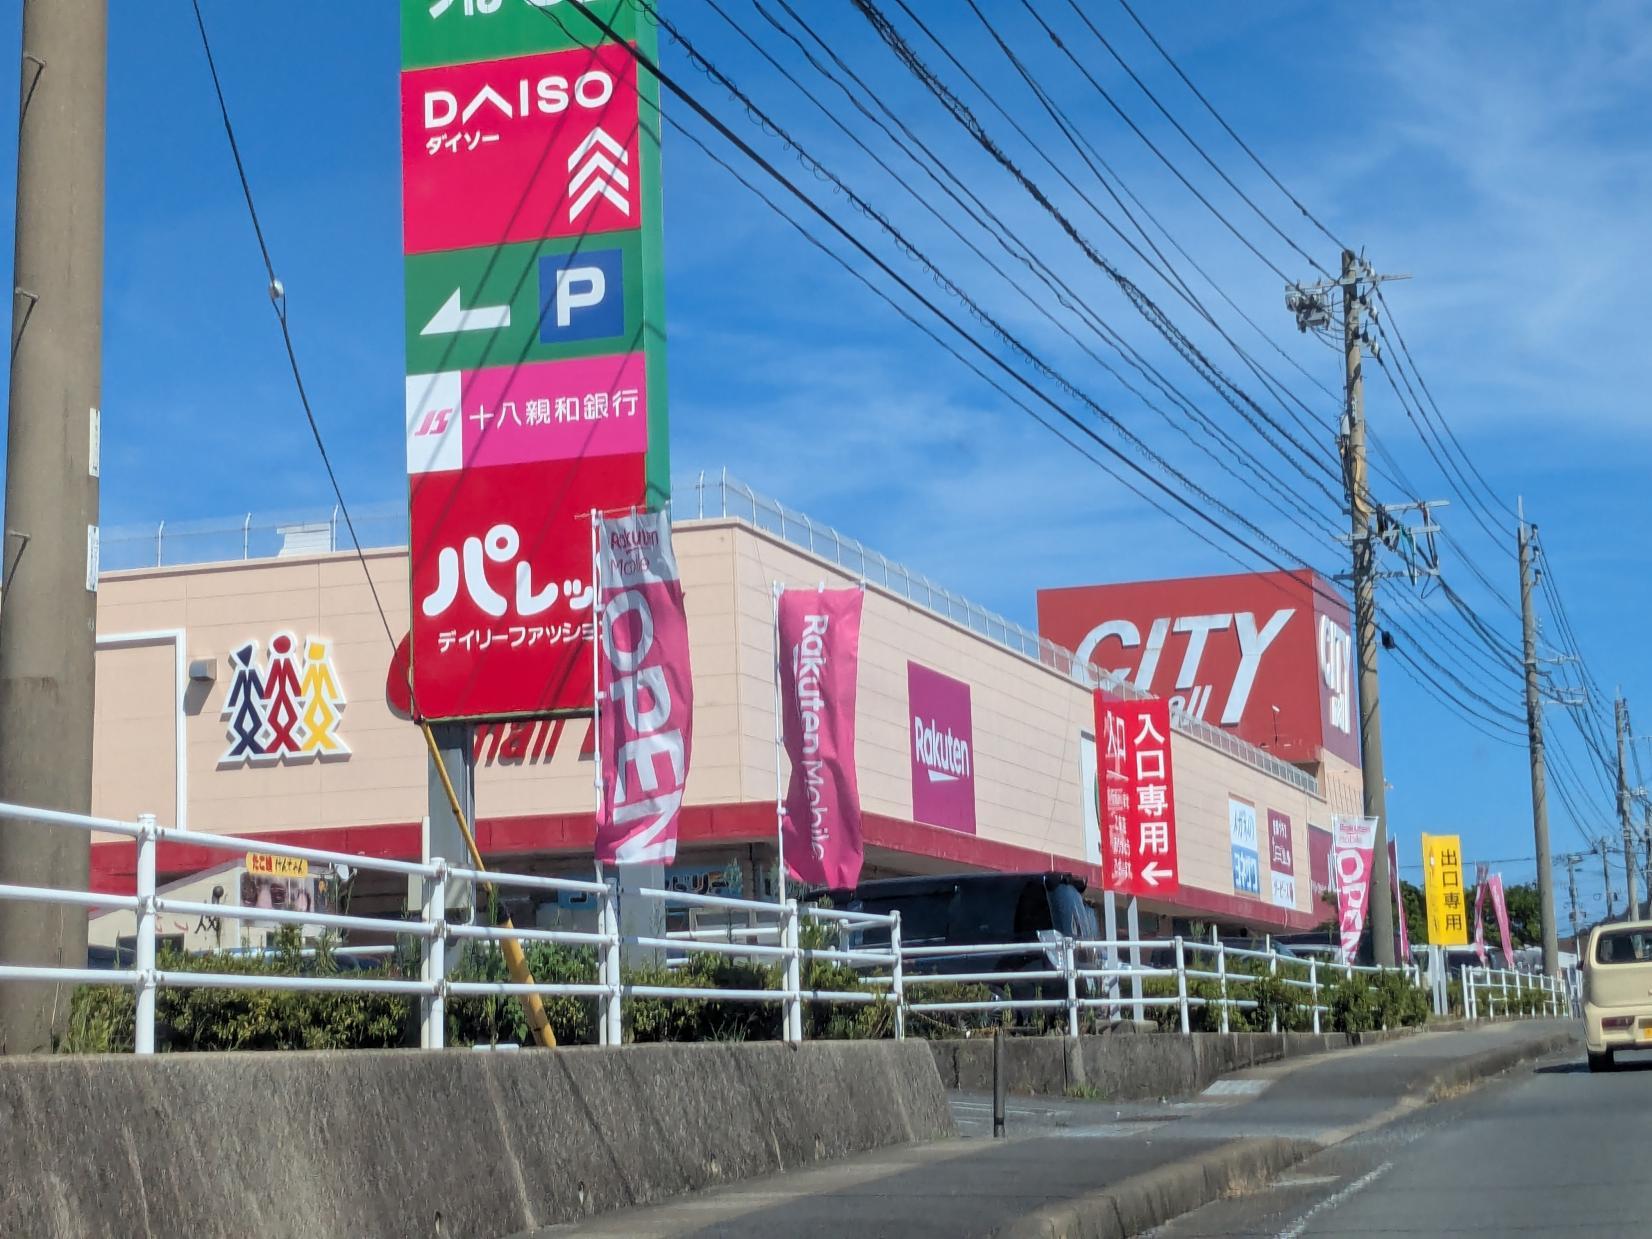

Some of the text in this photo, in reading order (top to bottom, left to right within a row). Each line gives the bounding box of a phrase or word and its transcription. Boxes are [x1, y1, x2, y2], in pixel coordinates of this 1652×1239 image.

[424, 70, 614, 129] DAISO
[426, 131, 500, 155] ダイソー
[556, 266, 606, 327] P
[469, 389, 639, 430] 十八親和銀行
[422, 524, 595, 617] パレッ
[437, 621, 604, 653] デイリーファッショ
[1072, 609, 1296, 724] CITY
[602, 589, 685, 865] OPEN
[800, 614, 829, 861] Rakuten Mobile
[914, 716, 970, 778] Rakuten
[1134, 713, 1169, 856] 入口専用
[1441, 849, 1463, 931] 出口専用
